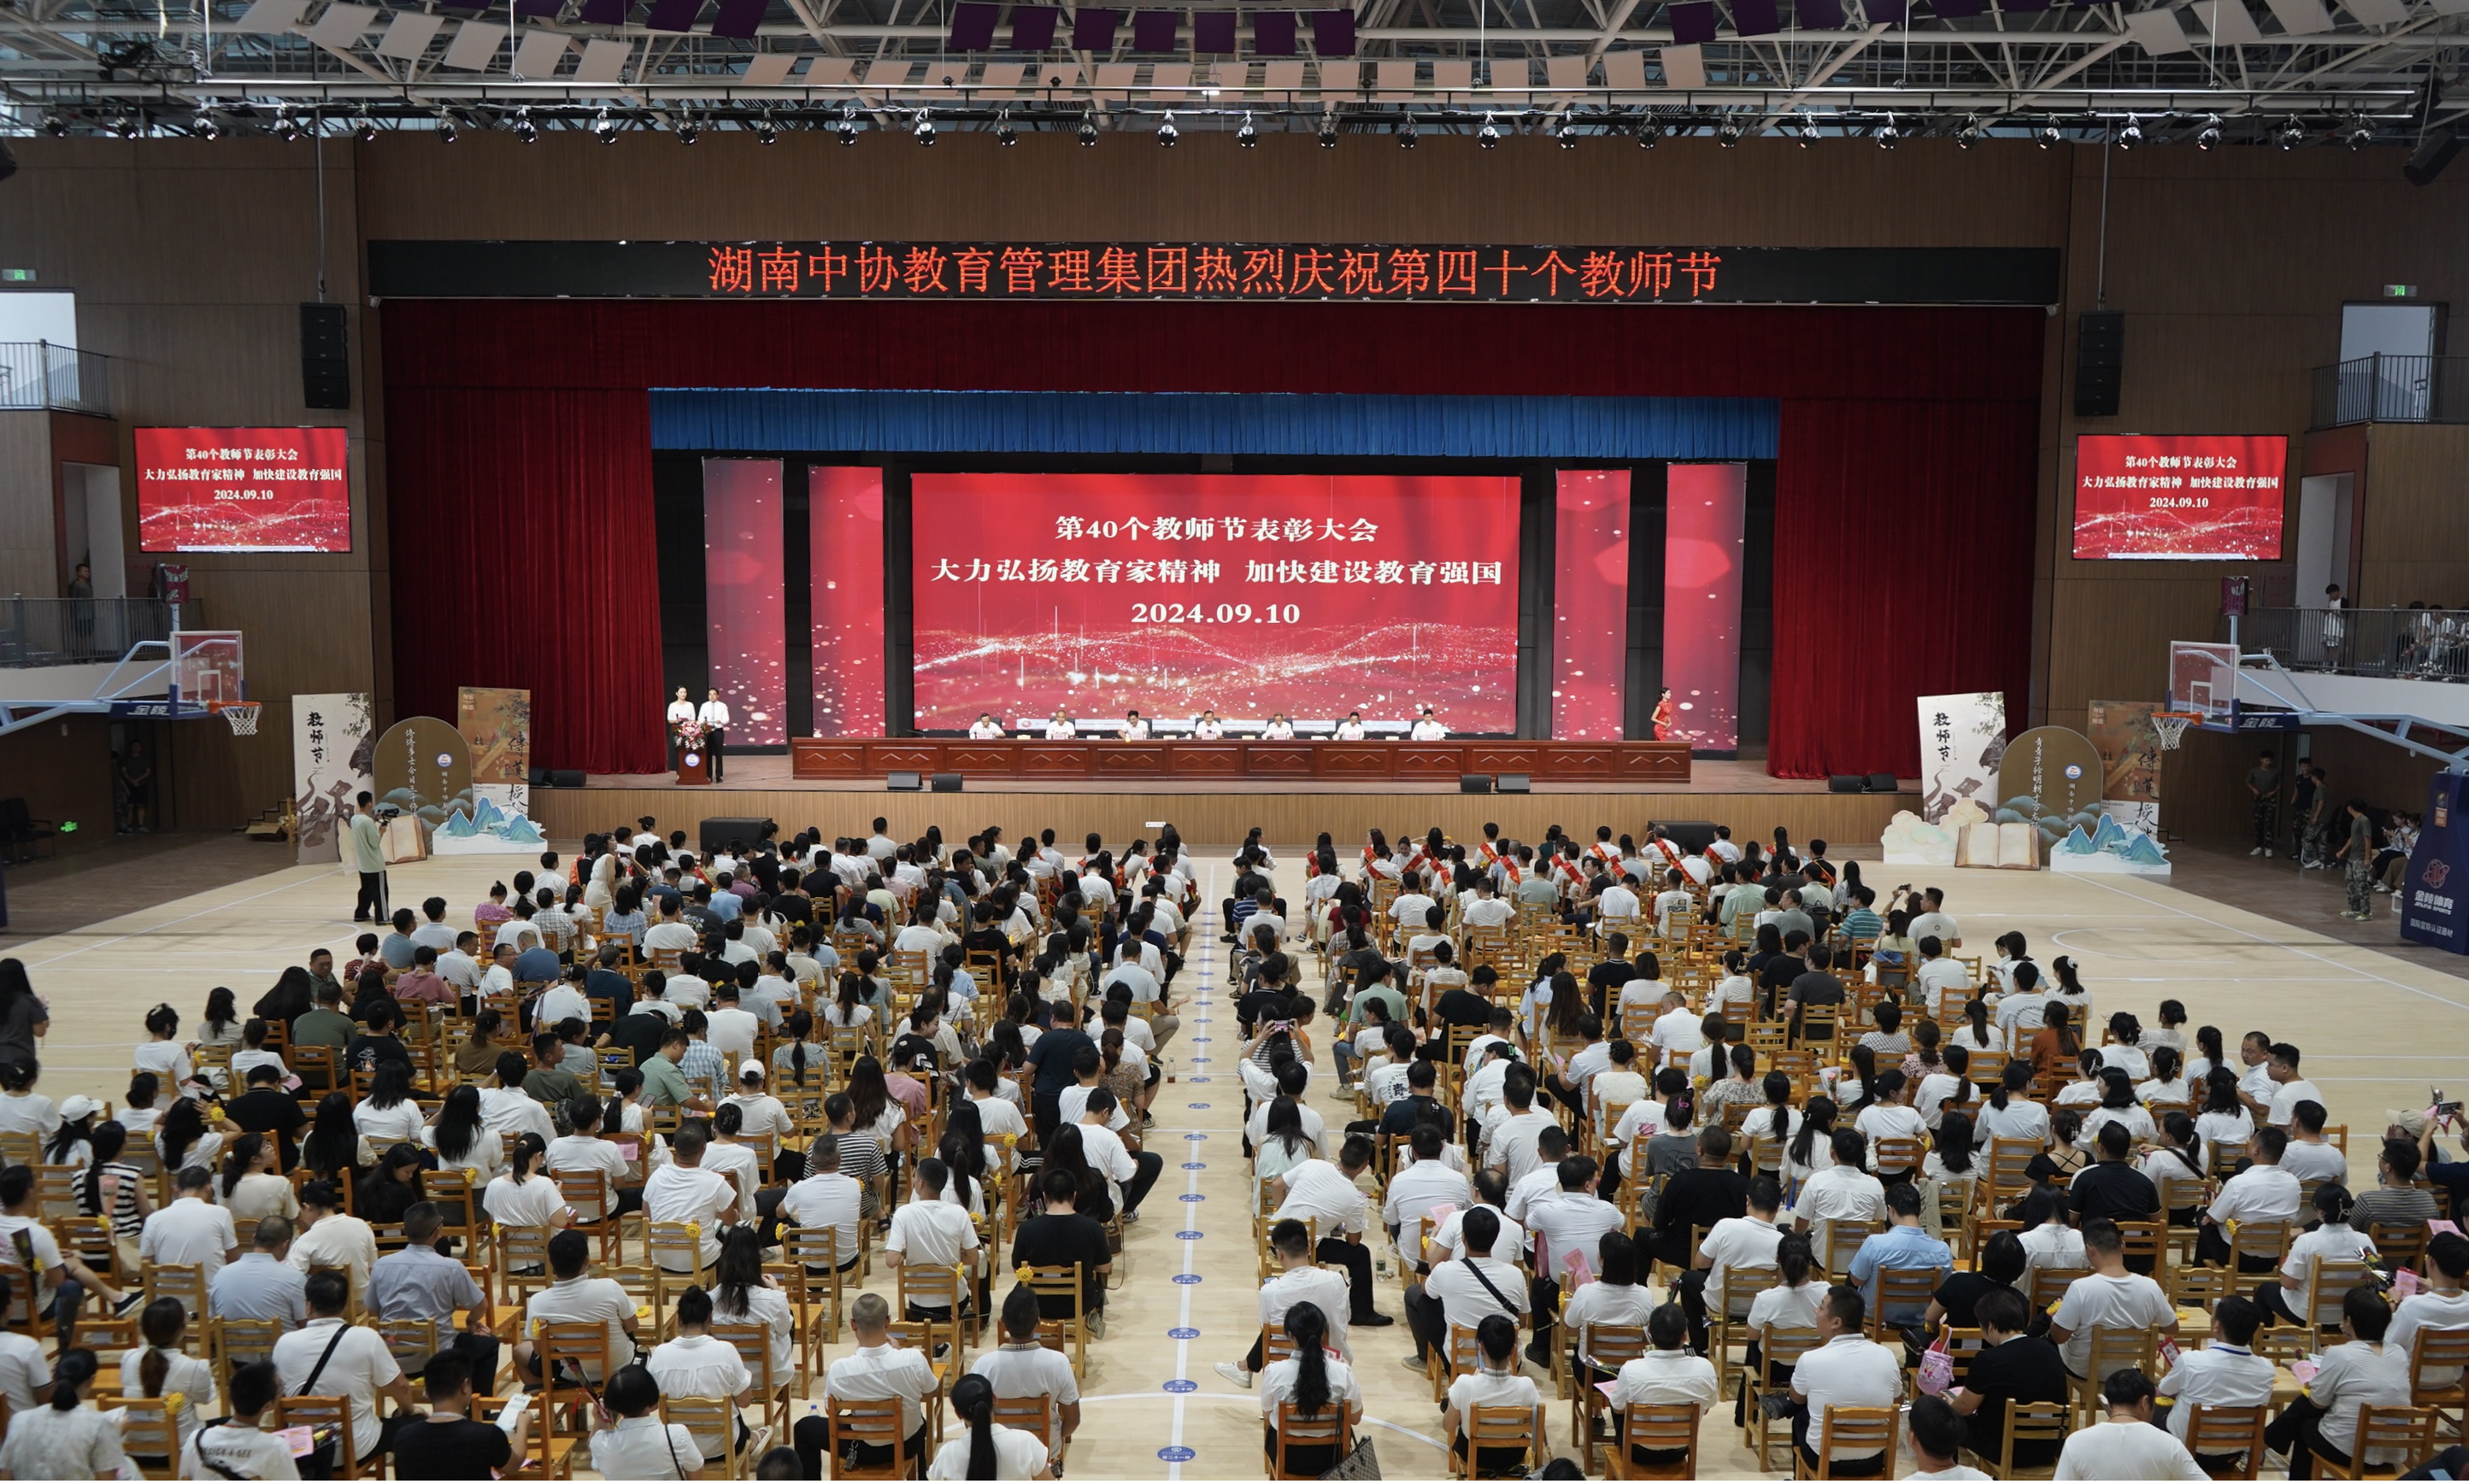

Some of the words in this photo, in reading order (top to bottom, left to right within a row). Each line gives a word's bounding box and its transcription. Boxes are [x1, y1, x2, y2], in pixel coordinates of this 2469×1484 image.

[708, 245, 1721, 296] 湖南中协教育管理集团热烈庆祝第四十个教师节
[185, 448, 298, 461] 第40个教师节表彰大会
[2125, 455, 2237, 469] 第40个教师节表彰大会
[144, 468, 245, 481] 大力弘扬教育家精神
[252, 468, 342, 481] 加快建设教育强国
[2083, 475, 2183, 489] 大力弘扬教育家精神
[2190, 476, 2279, 490] 加快建设教育强国
[214, 490, 273, 500] 2024.09.10
[2149, 496, 2209, 508] 2024.09.10
[1055, 515, 1379, 543] 第40个教师节表彰大会
[931, 558, 1221, 584] 大力弘扬教育家精神
[1244, 559, 1502, 585] 加快建设教育强国
[1131, 602, 1301, 624] 2024.09.10
[307, 711, 325, 764] 教师节
[1933, 712, 1951, 762] 教师节
